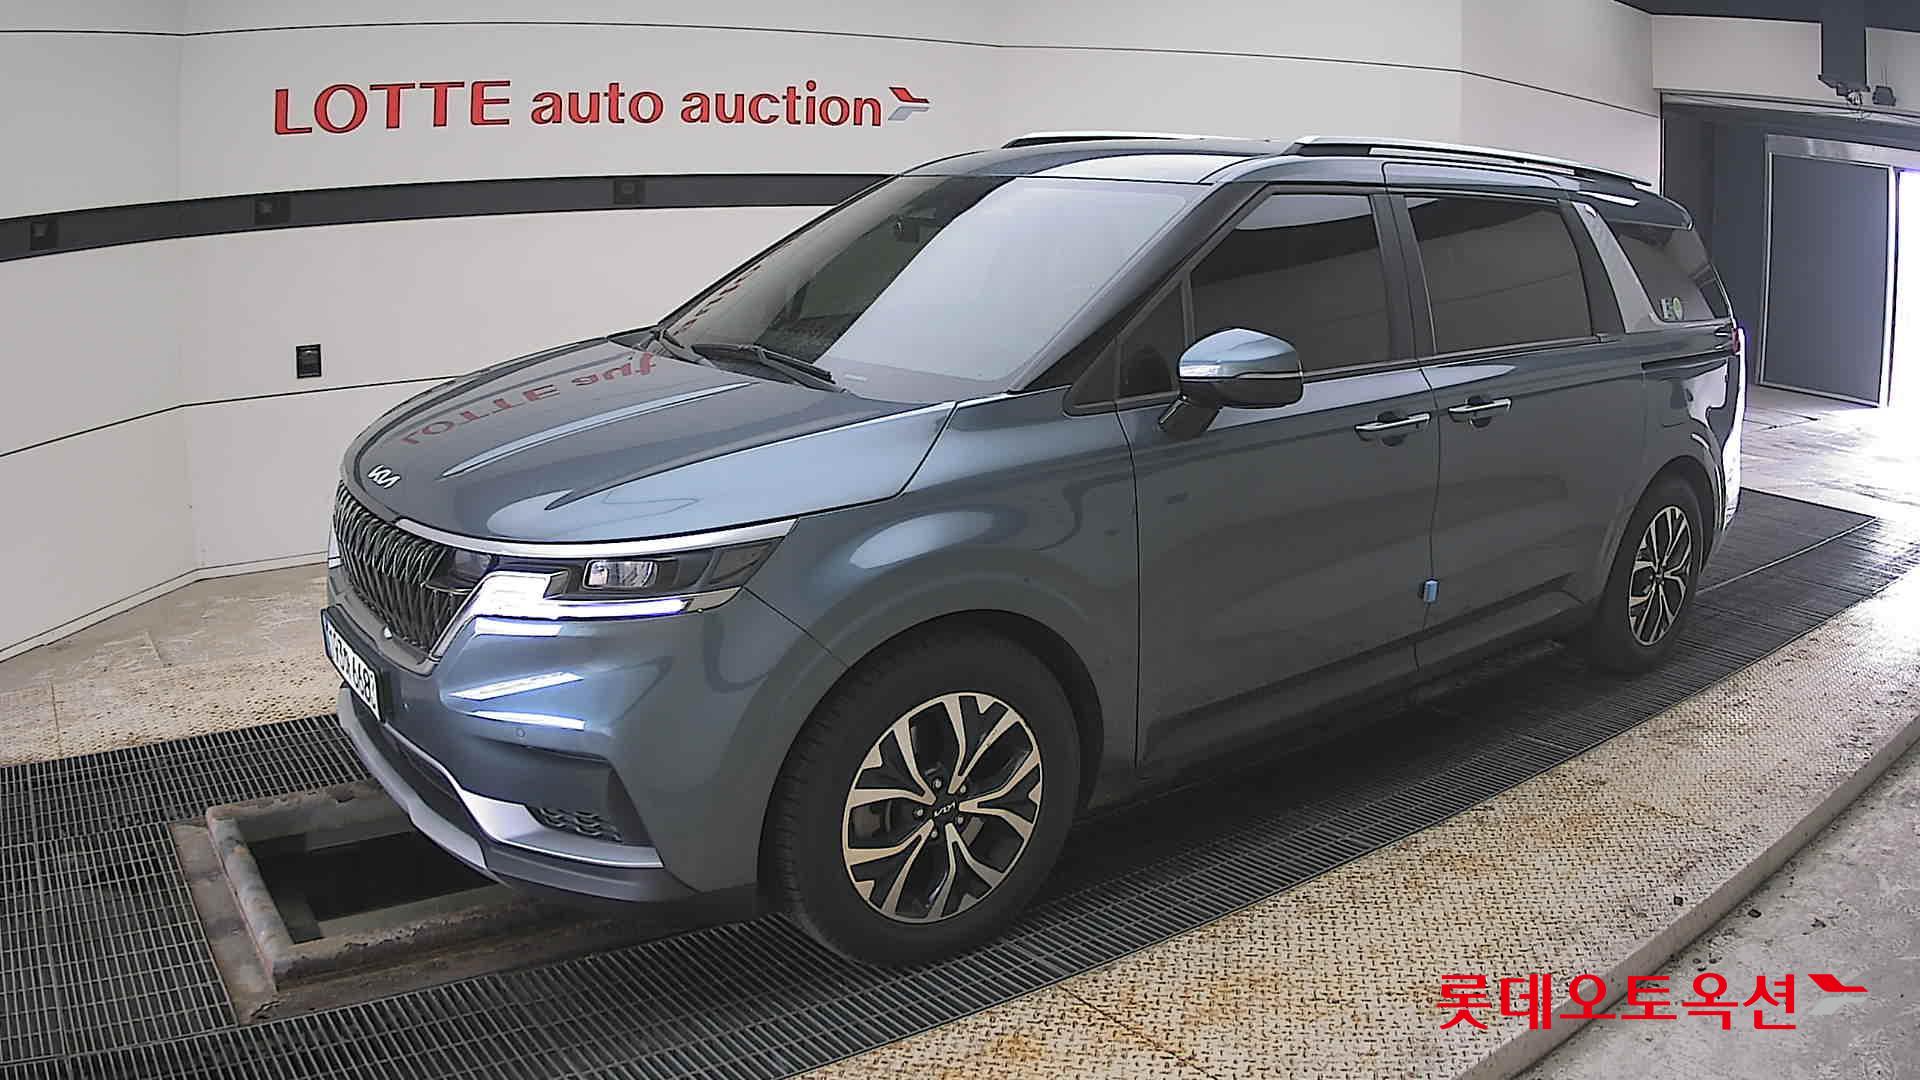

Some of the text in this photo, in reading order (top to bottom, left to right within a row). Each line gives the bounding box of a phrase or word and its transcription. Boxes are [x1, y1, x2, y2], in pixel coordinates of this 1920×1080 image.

[274, 80, 883, 136] LOTTE auto auction
